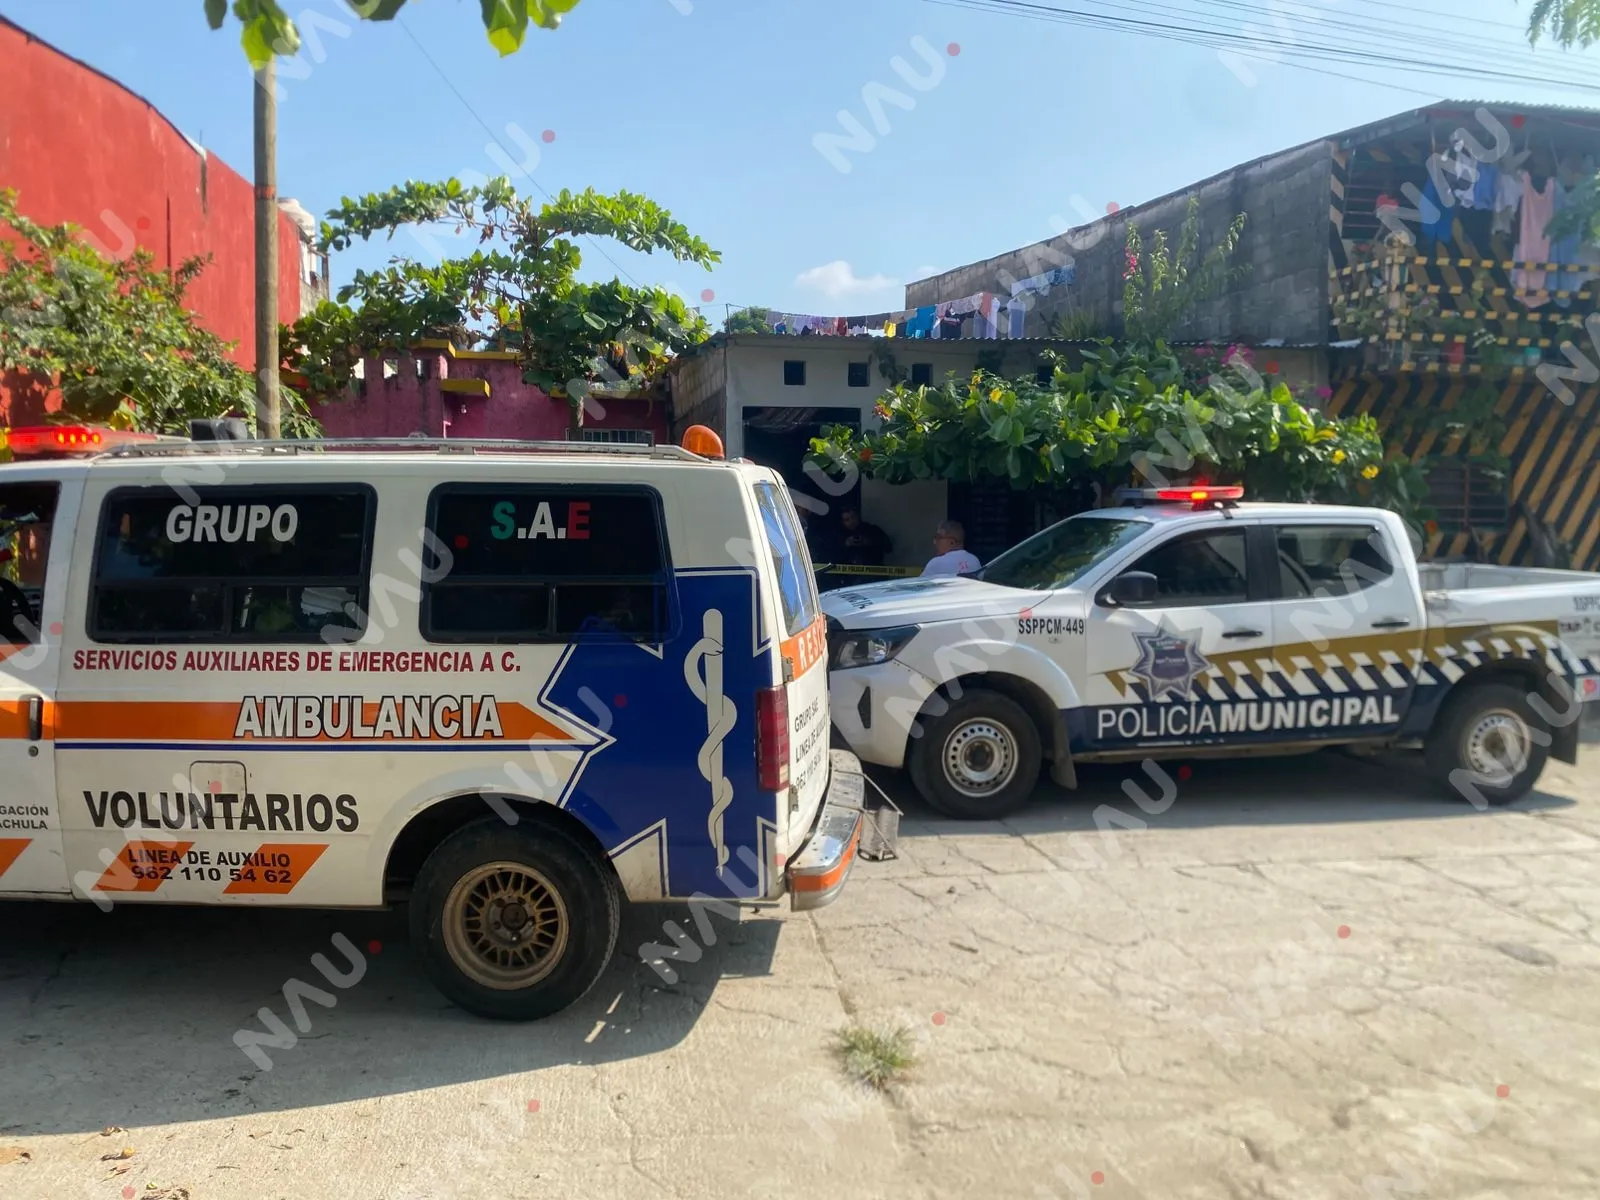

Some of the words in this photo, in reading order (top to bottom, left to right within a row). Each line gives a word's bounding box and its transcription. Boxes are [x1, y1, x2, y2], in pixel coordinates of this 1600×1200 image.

[166, 503, 298, 543] GRUPO
[490, 501, 591, 540] S.A.E
[1018, 618, 1084, 635] SSPPCM-449
[73, 650, 177, 671] SERVICIOS
[182, 650, 300, 672] AUXILIARES
[306, 651, 332, 672] DE
[339, 651, 474, 672] EMERGENCIA
[480, 651, 495, 672] A
[233, 695, 503, 739] AMBULANCIA
[1219, 695, 1400, 733] MUNICIPAL
[0, 819, 48, 830] CHULA
[83, 790, 359, 832] VOLUNTARIOS
[187, 851, 211, 865] DE
[216, 851, 291, 867] AUXILIO
[130, 866, 173, 880] 962
[180, 867, 221, 881] 110
[229, 868, 257, 882] 54
[264, 870, 292, 883] 62
